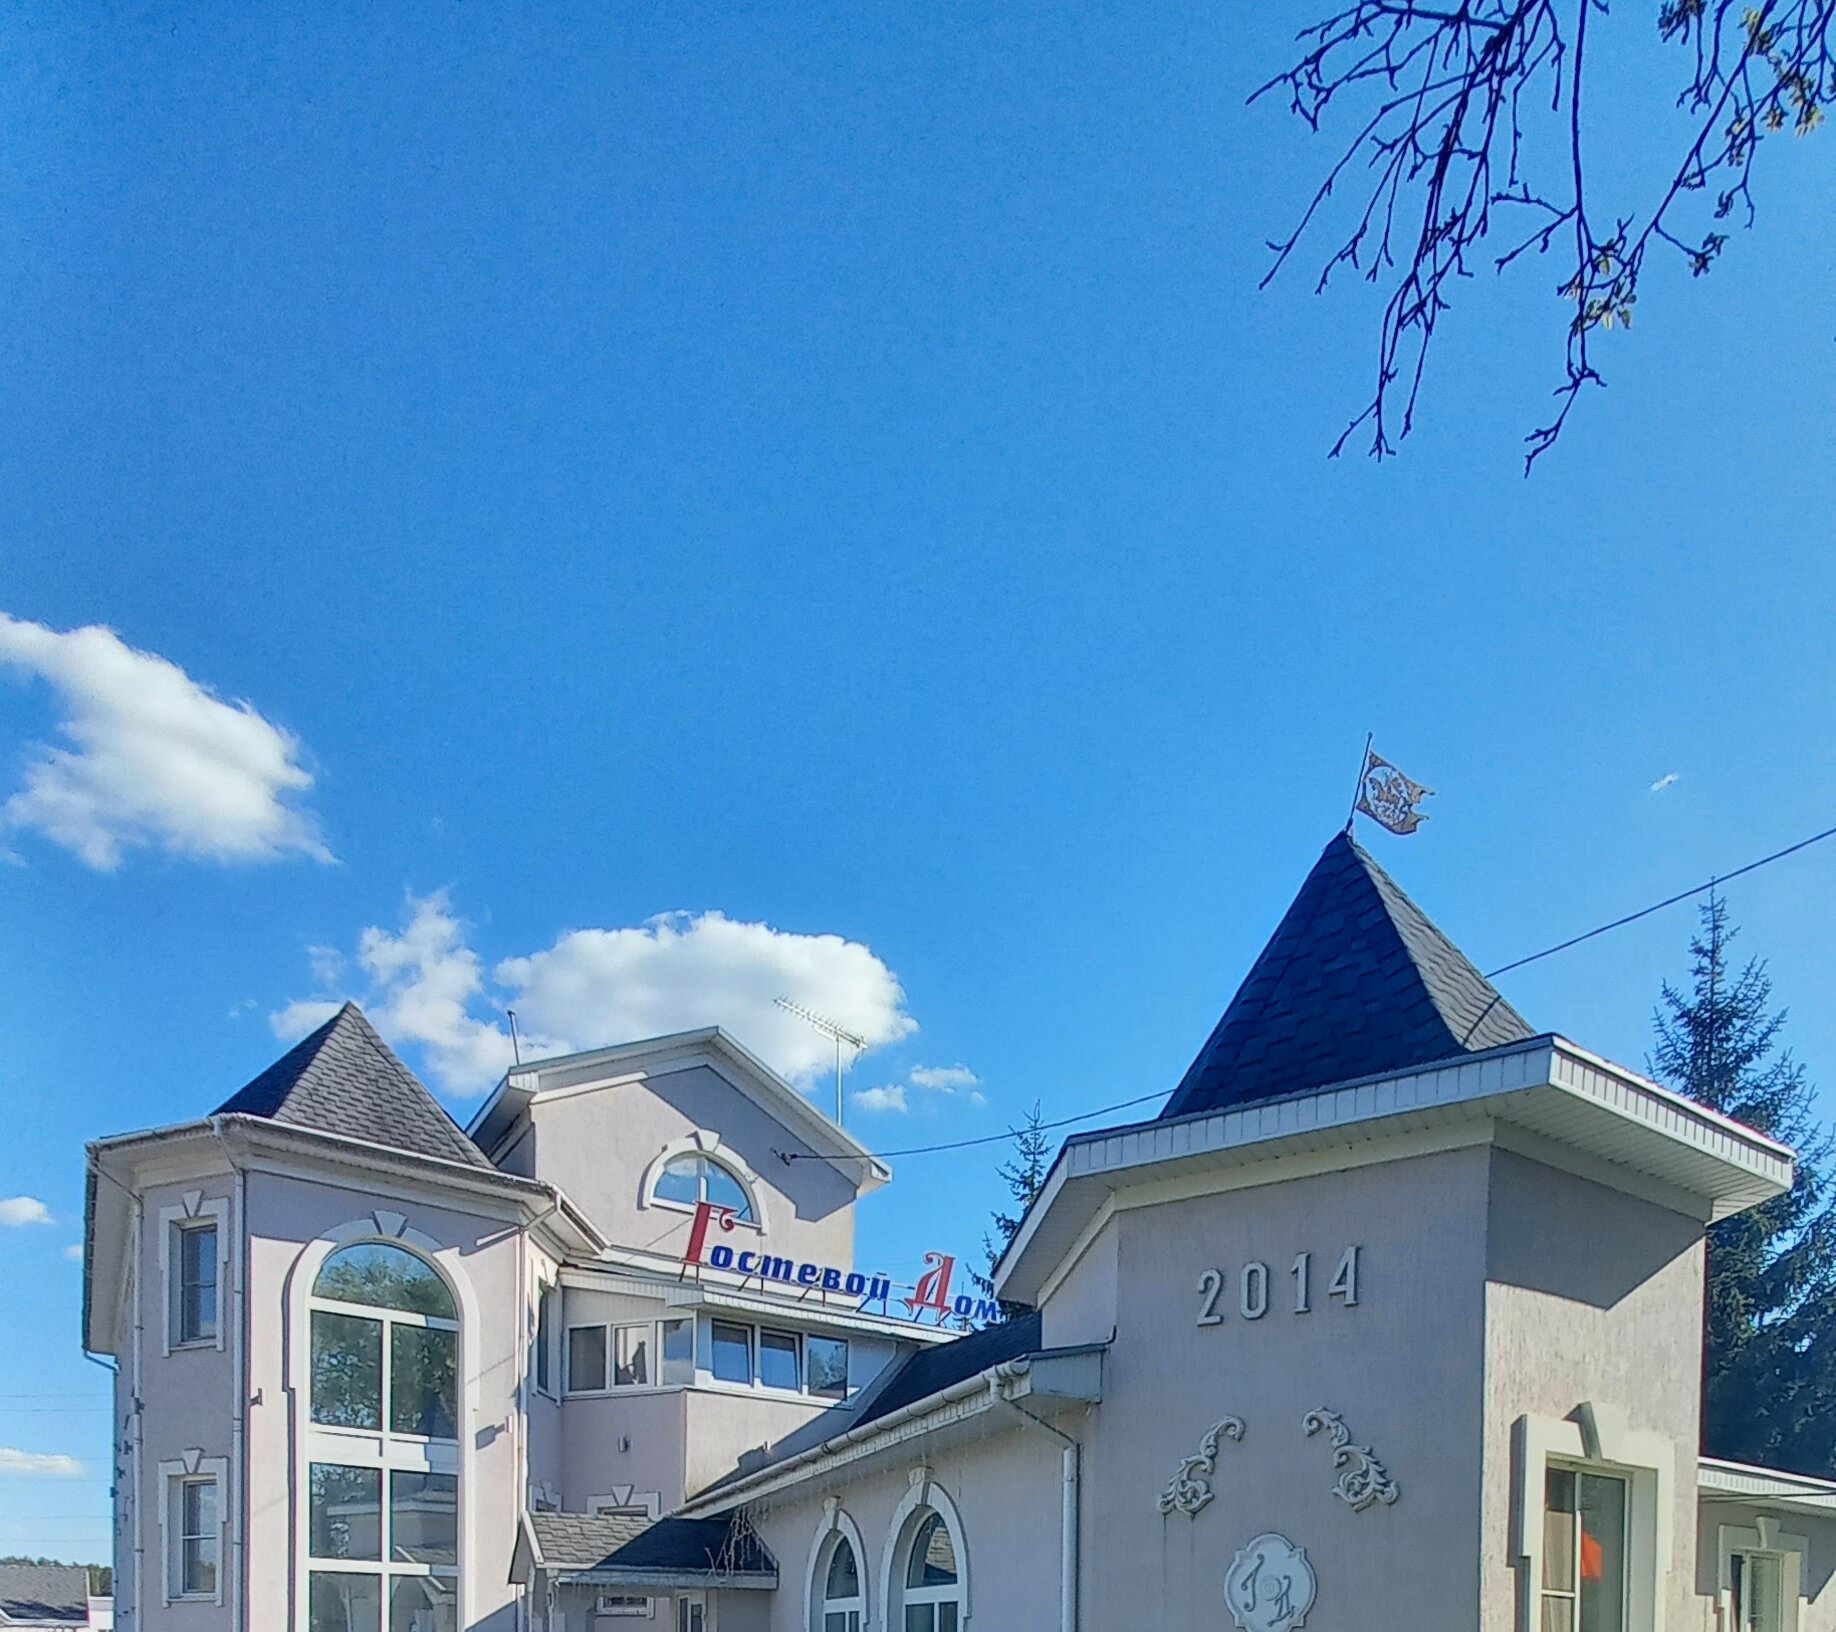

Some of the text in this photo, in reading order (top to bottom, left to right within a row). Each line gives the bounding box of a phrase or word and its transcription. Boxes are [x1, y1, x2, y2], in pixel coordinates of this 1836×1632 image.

[681, 1200, 998, 1322] Гостевой Дом
[1197, 1245, 1361, 1327] 2014
